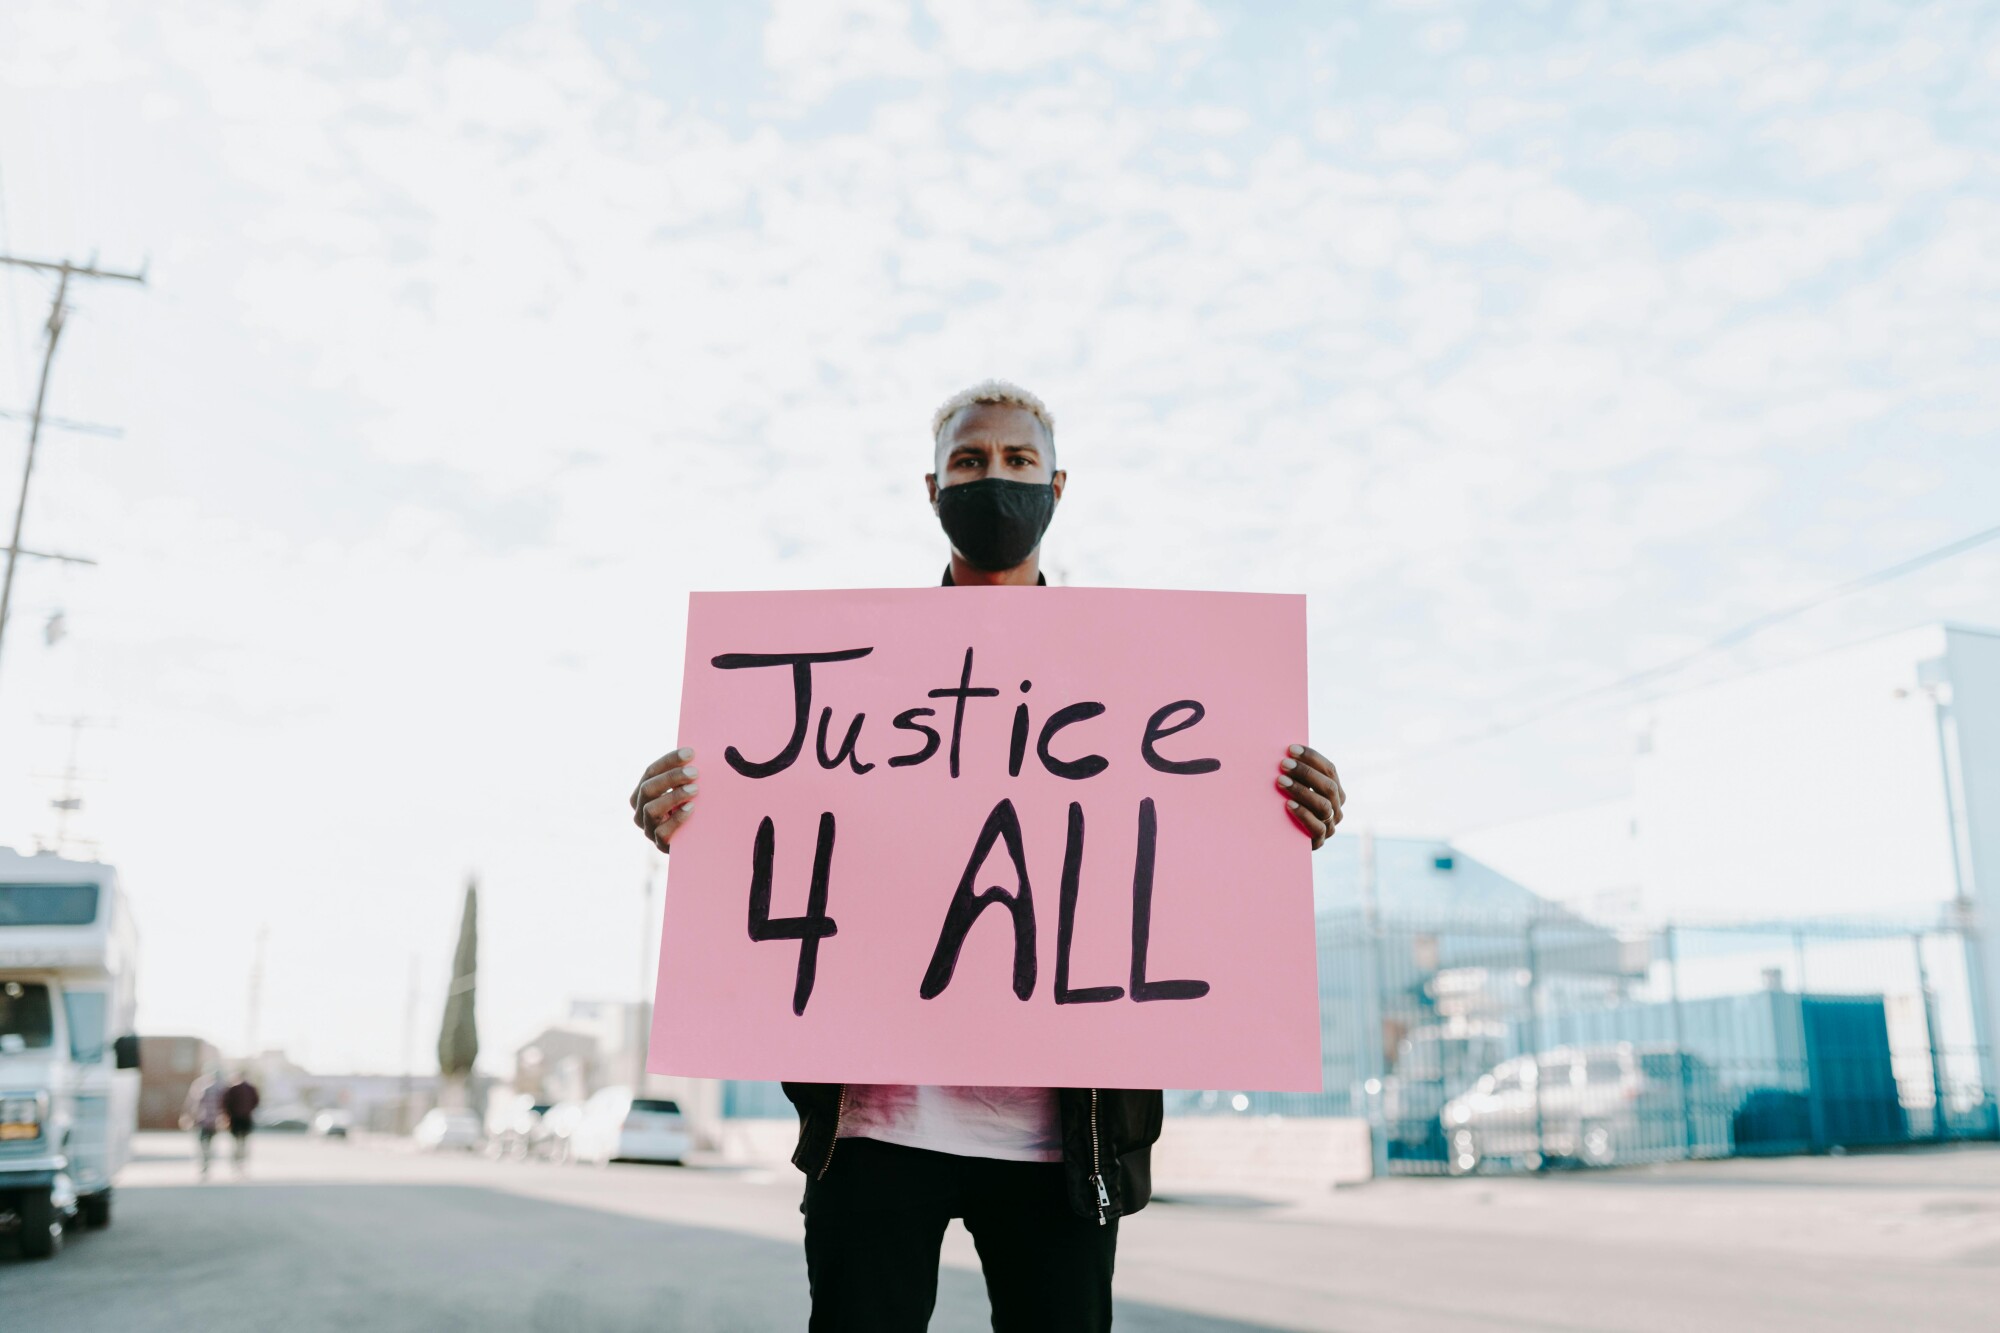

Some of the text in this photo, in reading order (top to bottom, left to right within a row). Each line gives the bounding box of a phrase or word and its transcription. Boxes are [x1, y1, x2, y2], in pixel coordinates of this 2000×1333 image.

[710, 646, 1222, 780] Justice
[747, 797, 1210, 1017] 4 ALL
